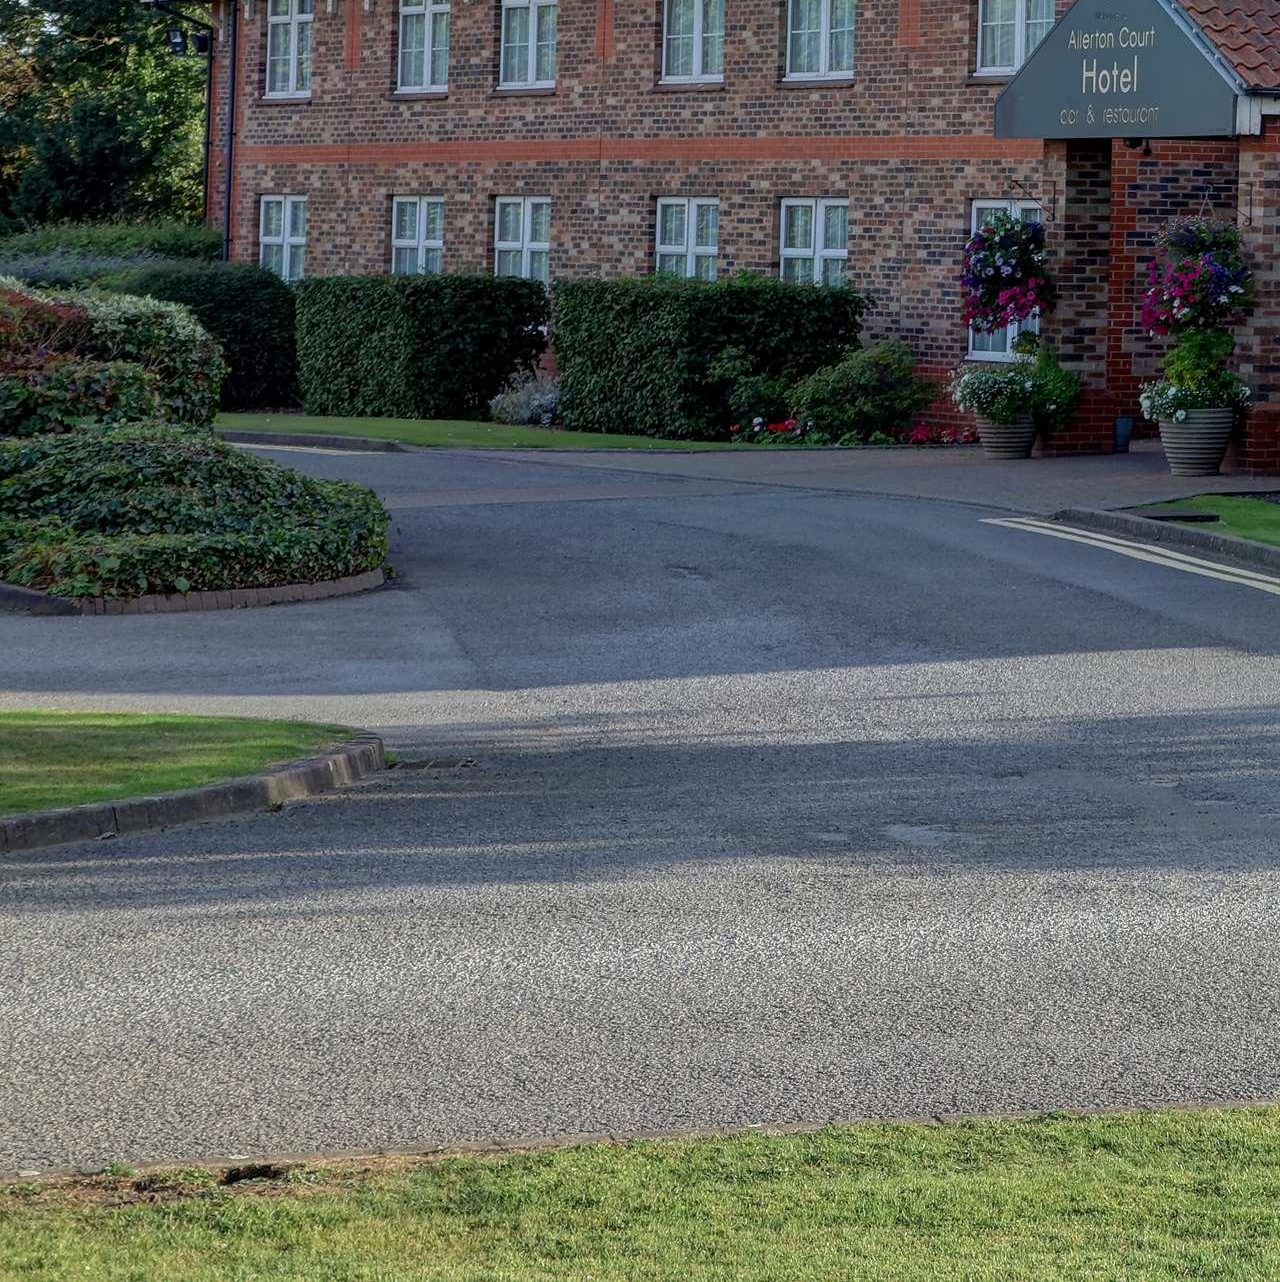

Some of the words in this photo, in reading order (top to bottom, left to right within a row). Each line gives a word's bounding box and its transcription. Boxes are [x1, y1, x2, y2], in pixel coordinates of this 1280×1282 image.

[1068, 29, 1114, 50] Allerton
[1119, 26, 1155, 48] Court
[1082, 55, 1138, 94] Hotel
[1086, 104, 1096, 125] &
[1103, 106, 1159, 125] restaurant
